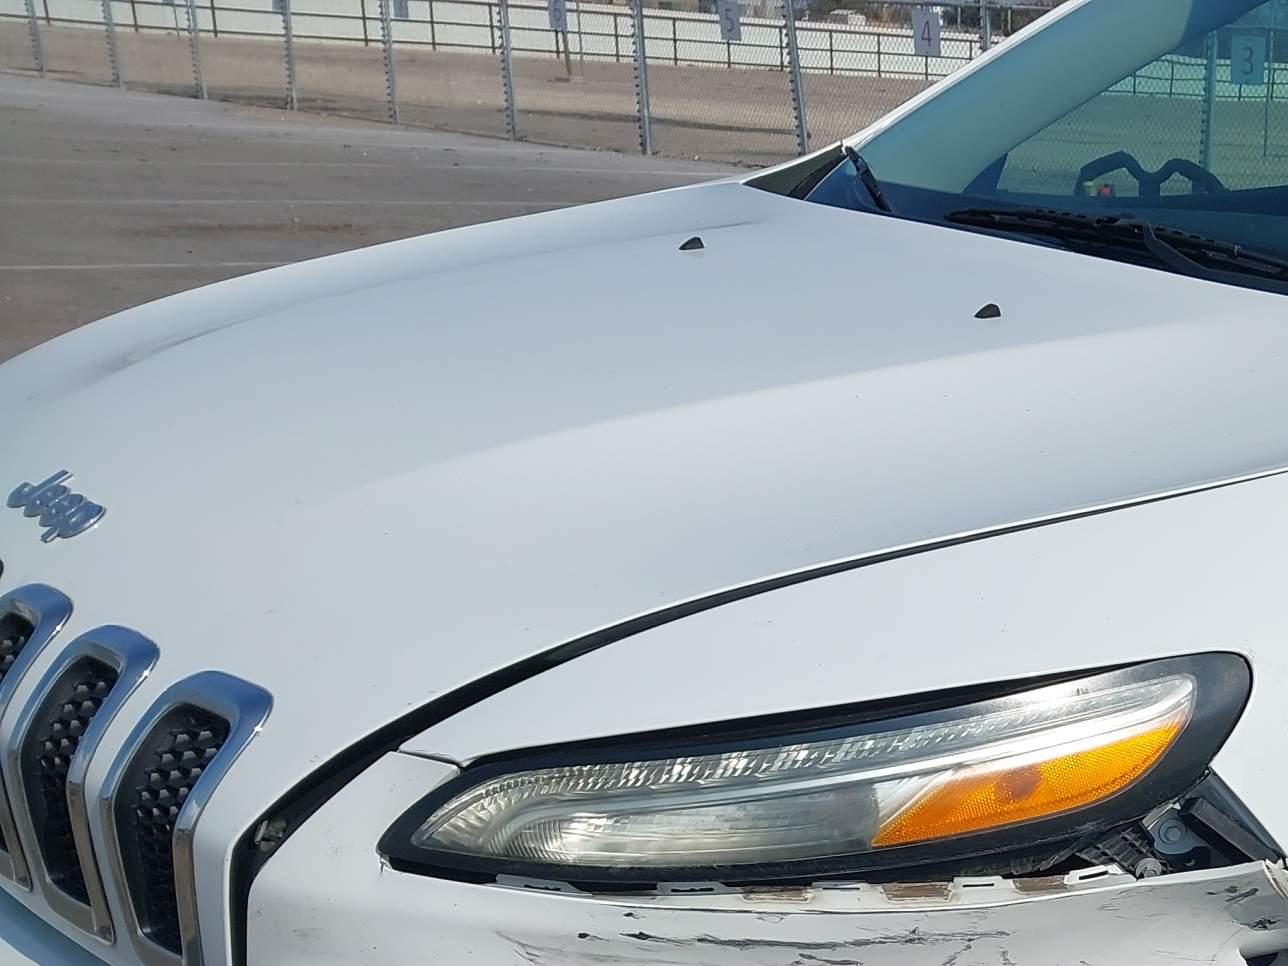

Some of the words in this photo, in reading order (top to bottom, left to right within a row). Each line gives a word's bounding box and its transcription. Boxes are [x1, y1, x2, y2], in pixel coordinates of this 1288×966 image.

[724, 8, 735, 33] 5
[920, 20, 932, 47] 4
[1241, 46, 1254, 75] 3
[6, 468, 107, 544] Jeep
